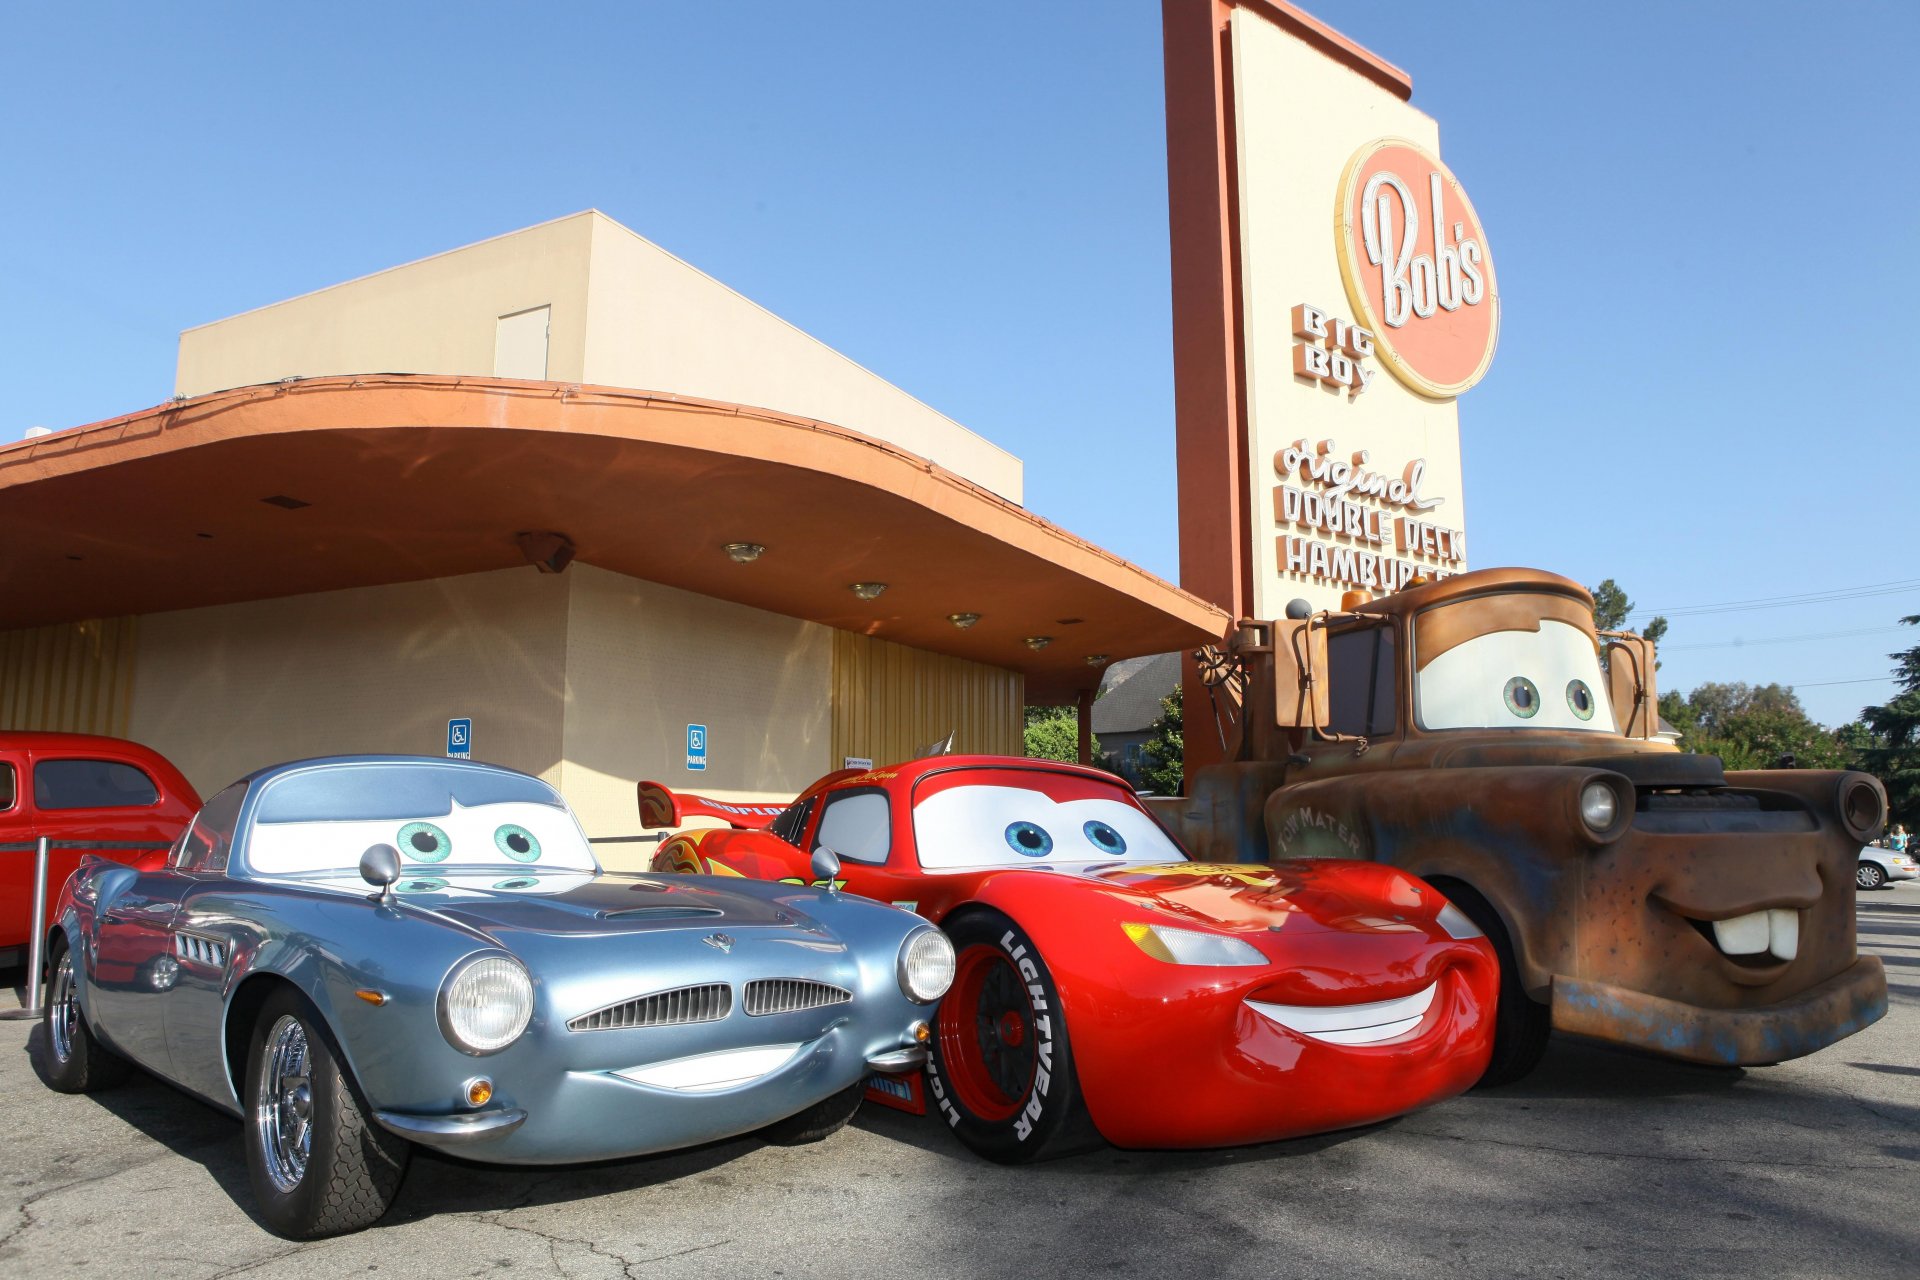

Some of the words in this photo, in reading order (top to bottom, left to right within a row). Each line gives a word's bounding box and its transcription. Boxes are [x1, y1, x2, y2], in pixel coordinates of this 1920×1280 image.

[1361, 170, 1485, 329] Bob's
[1298, 302, 1375, 358] BIG
[1298, 343, 1377, 398] BOY
[1277, 438, 1446, 516] original
[1278, 485, 1393, 545] DOUBLE
[1400, 517, 1465, 563] DECK
[1280, 534, 1458, 591] HAMBUR
[687, 755, 706, 765] PARKING
[1277, 814, 1299, 853] TOW
[1299, 806, 1361, 855] MATER
[999, 929, 1053, 1142] LIGHTYEAR
